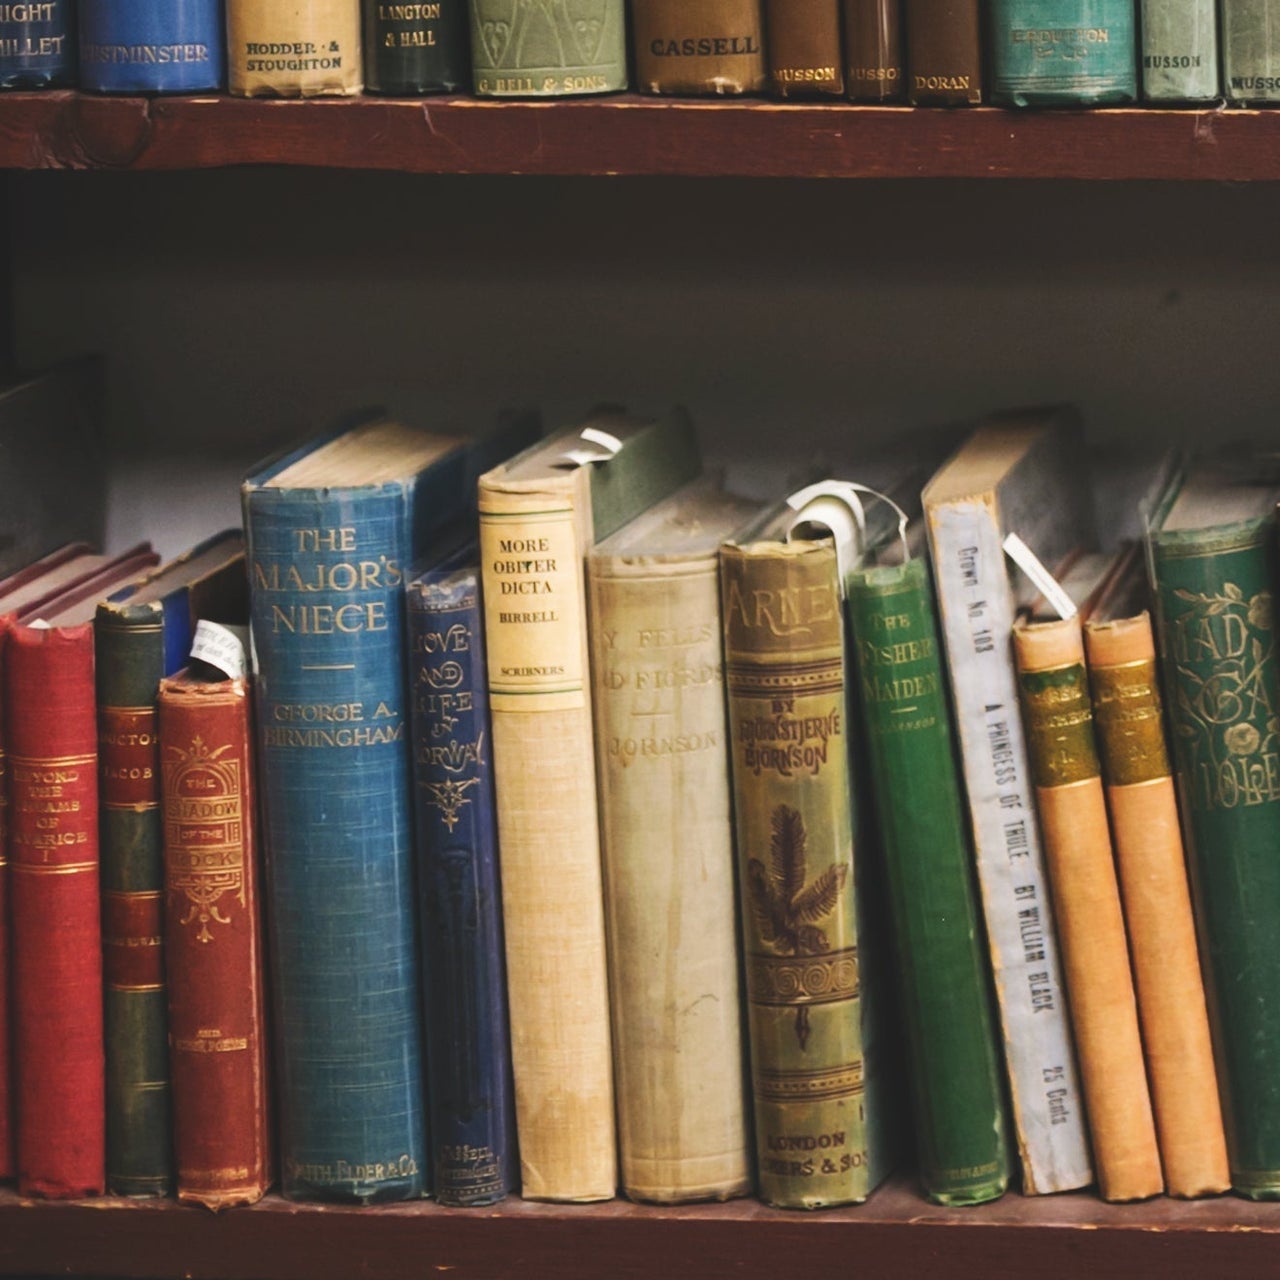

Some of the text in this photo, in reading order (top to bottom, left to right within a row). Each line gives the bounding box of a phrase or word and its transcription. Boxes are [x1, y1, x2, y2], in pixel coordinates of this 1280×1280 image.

[401, 31, 435, 47] HALL
[247, 42, 316, 56] HODDER
[650, 38, 760, 57] CASSELL
[247, 57, 341, 71] STOUGHTON
[915, 76, 970, 90] DORAN
[296, 528, 356, 552] THE
[500, 539, 550, 553] MORE
[255, 555, 403, 592] MAJOR'S
[493, 559, 557, 574] OBITER
[501, 581, 552, 594] DICTA
[273, 604, 388, 634] NIECE
[499, 612, 558, 623] BIRRELL
[501, 666, 565, 676] SCRIBNERS
[275, 703, 363, 722] GEORGE
[265, 721, 403, 747] BIRMINGHAM
[987, 716, 1017, 786] PRINCESS
[1014, 884, 1054, 1014] BY WILLIAM BLACK
